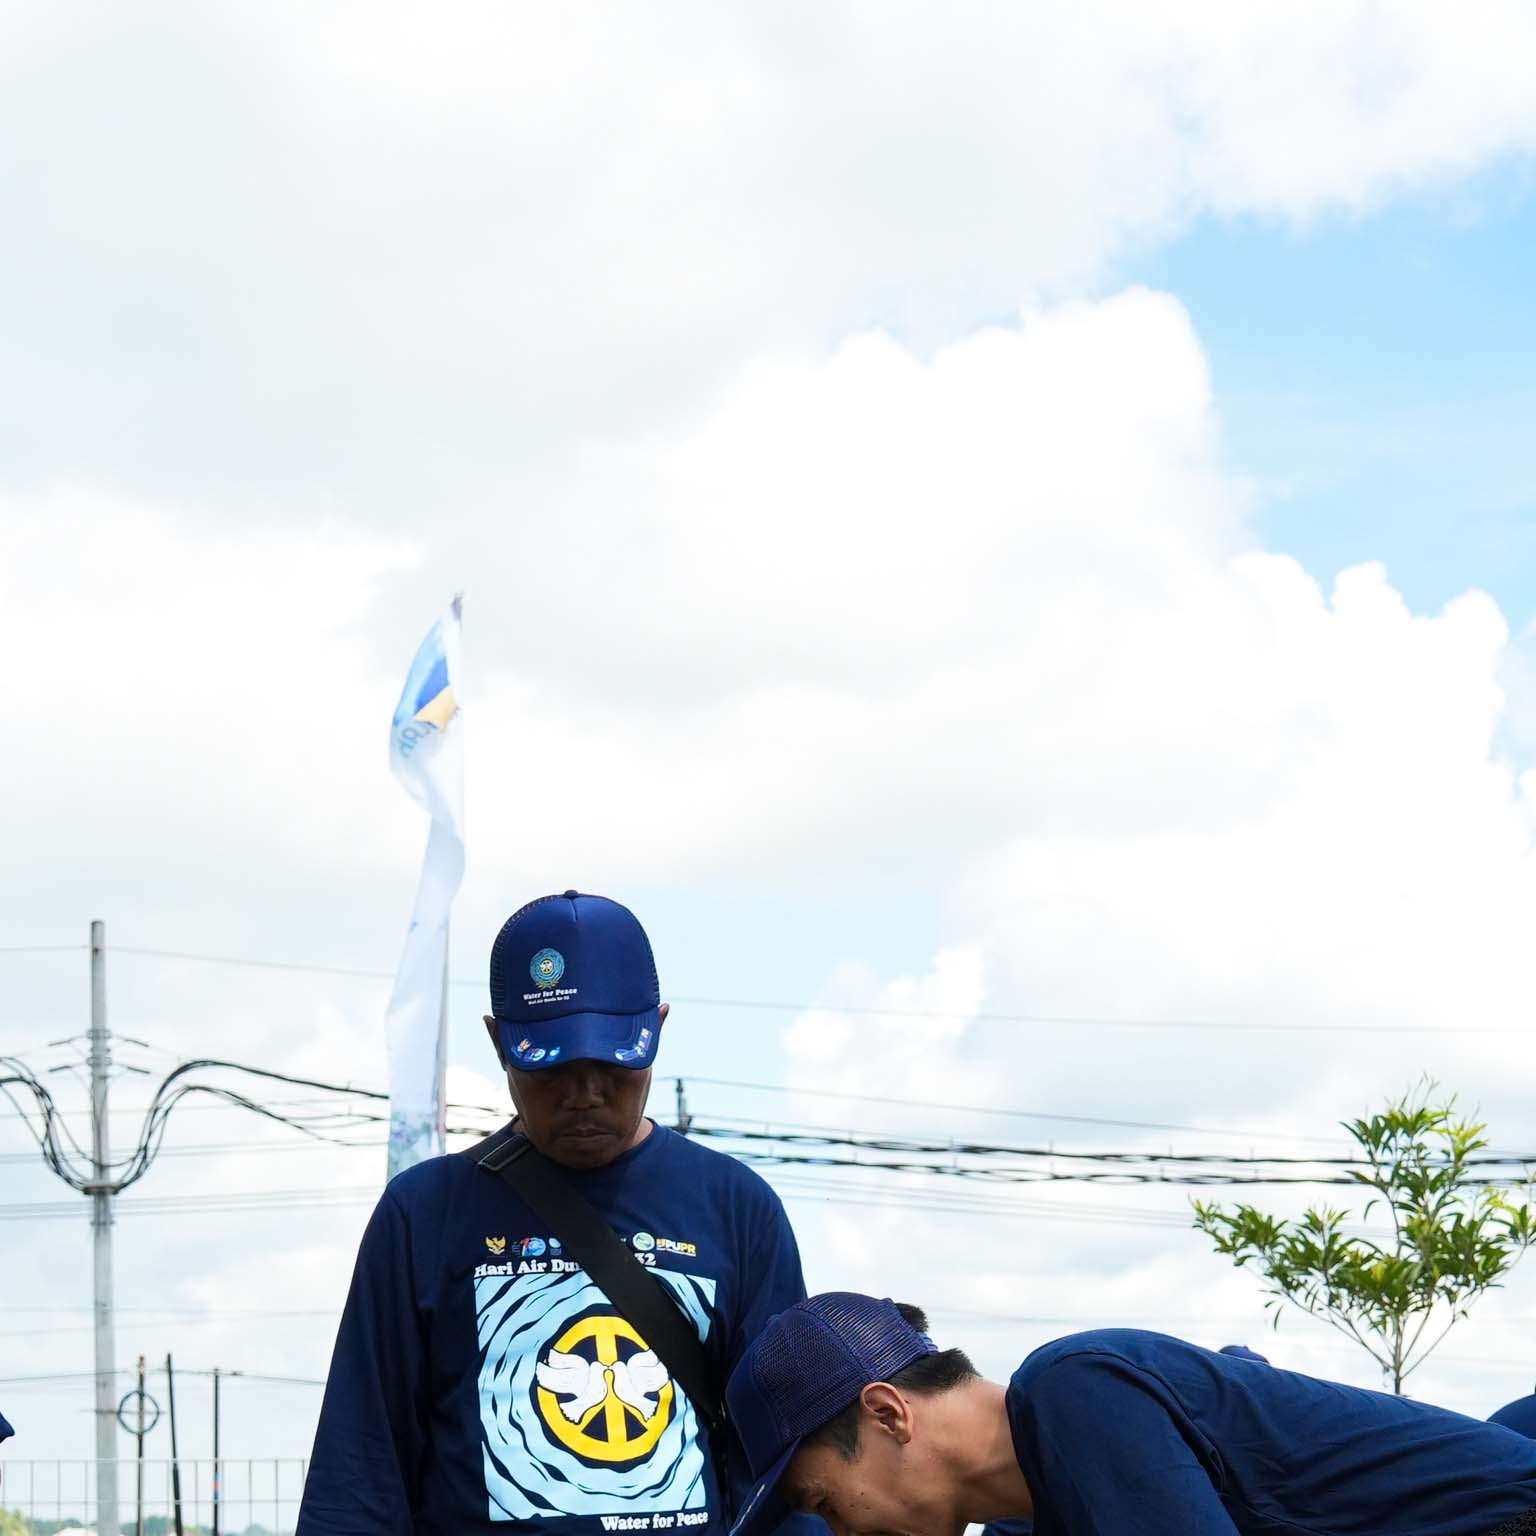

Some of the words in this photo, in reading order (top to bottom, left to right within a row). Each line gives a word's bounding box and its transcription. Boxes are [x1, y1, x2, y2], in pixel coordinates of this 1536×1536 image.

[473, 1261, 514, 1278] Hari
[517, 1259, 548, 1275] Air
[600, 1515, 650, 1531] Water
[652, 1513, 674, 1529] for
[676, 1511, 709, 1527] Peace
